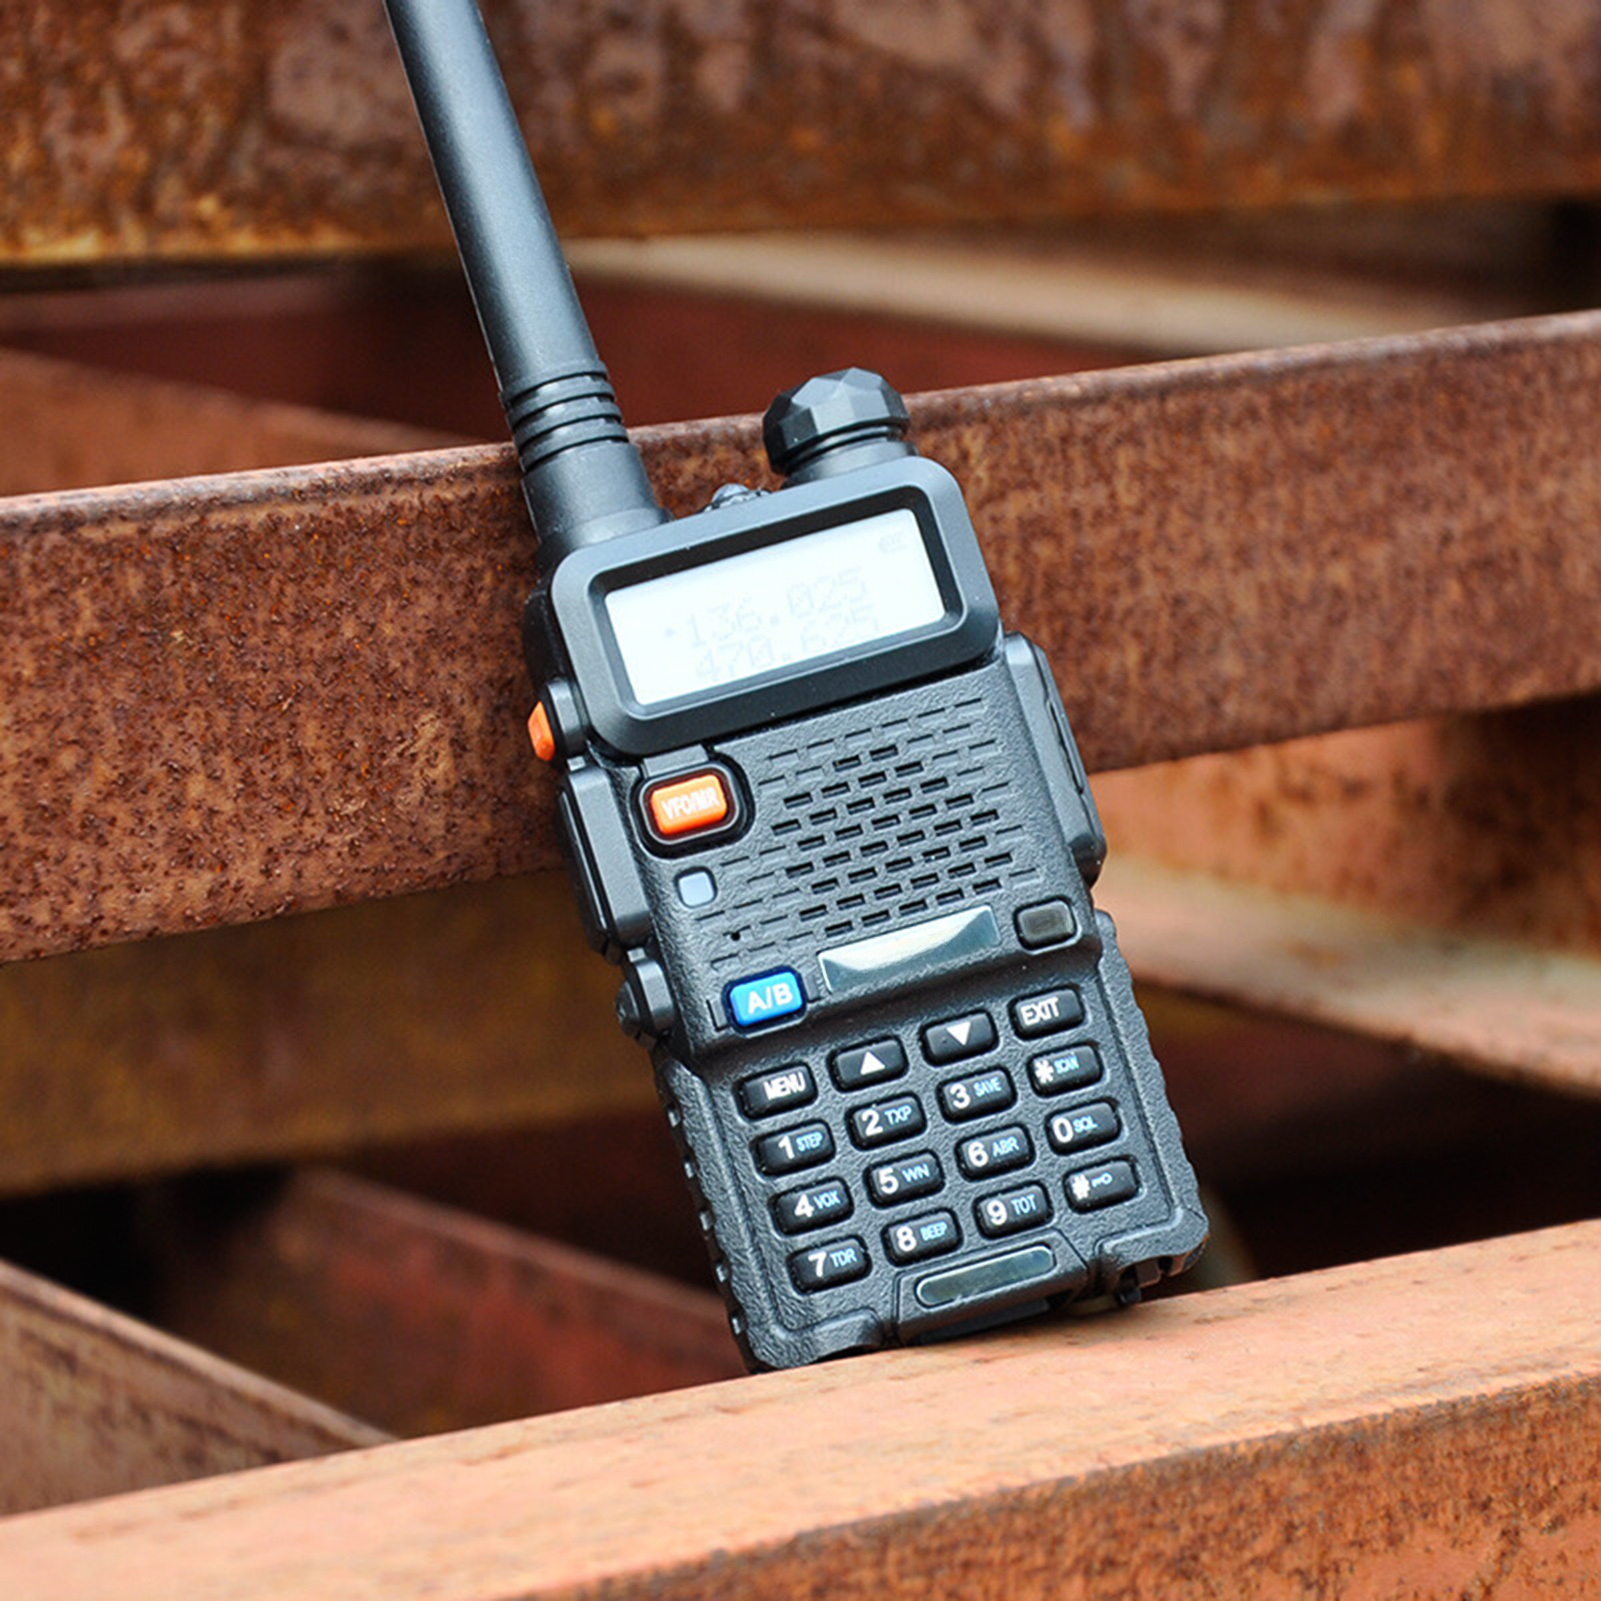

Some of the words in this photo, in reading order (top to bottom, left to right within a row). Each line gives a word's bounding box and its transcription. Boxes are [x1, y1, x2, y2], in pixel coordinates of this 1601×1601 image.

[747, 983, 793, 1014] A/B
[1020, 997, 1059, 1026] EXIT
[763, 1072, 806, 1100] MENU
[949, 1084, 971, 1109] 3
[862, 1109, 883, 1137] 2
[884, 1105, 912, 1125] TXP
[1052, 1118, 1074, 1143] 0
[778, 1135, 795, 1160] 1
[796, 1131, 823, 1151] STEP
[968, 1141, 989, 1167] 6
[992, 1136, 1020, 1157] ABR
[878, 1167, 899, 1194] 5
[794, 1194, 815, 1218] 4
[813, 1190, 841, 1209] VOX
[987, 1199, 1008, 1226] 9
[1011, 1194, 1037, 1215] TOT
[896, 1226, 917, 1252] 8
[919, 1221, 948, 1241] BEEP
[808, 1251, 827, 1278] 7
[830, 1248, 857, 1268] TDR
